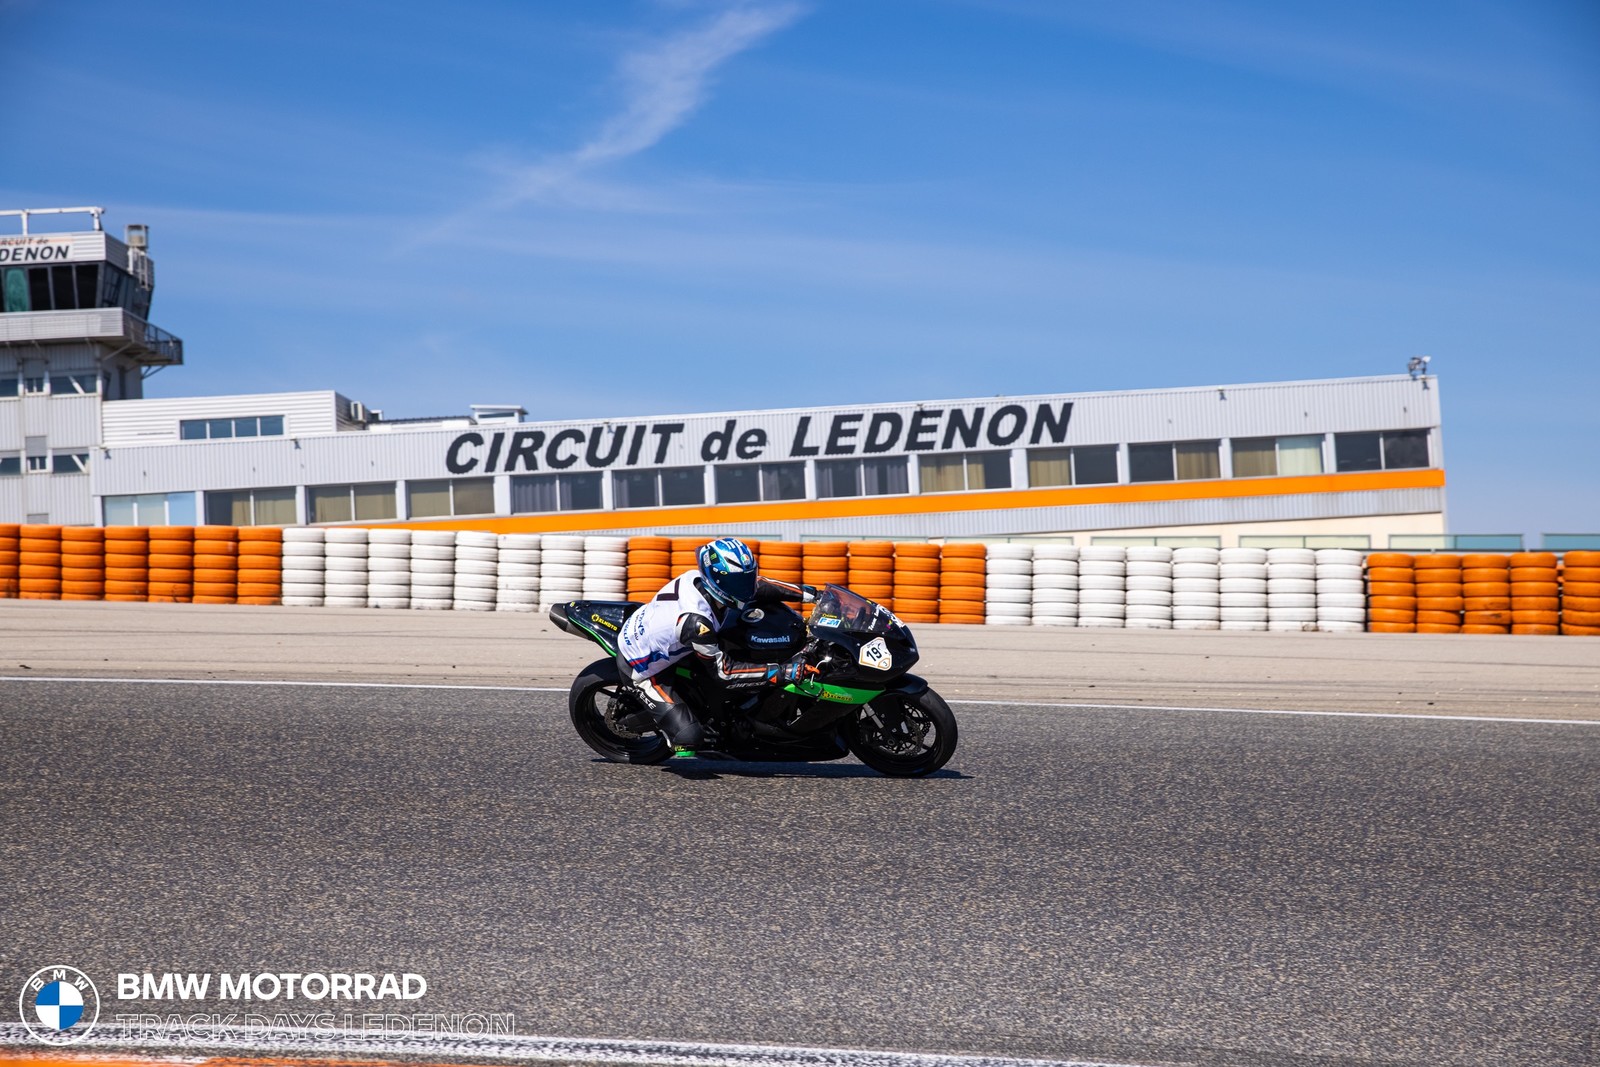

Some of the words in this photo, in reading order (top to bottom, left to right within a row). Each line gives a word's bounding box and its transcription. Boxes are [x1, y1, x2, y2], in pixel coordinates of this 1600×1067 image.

[0, 245, 70, 262] DENON
[445, 423, 685, 474] CIRCUIT
[700, 419, 767, 462] de
[789, 402, 1073, 457] LEDENON
[750, 635, 790, 643] Kawasaki
[866, 647, 882, 661] 19
